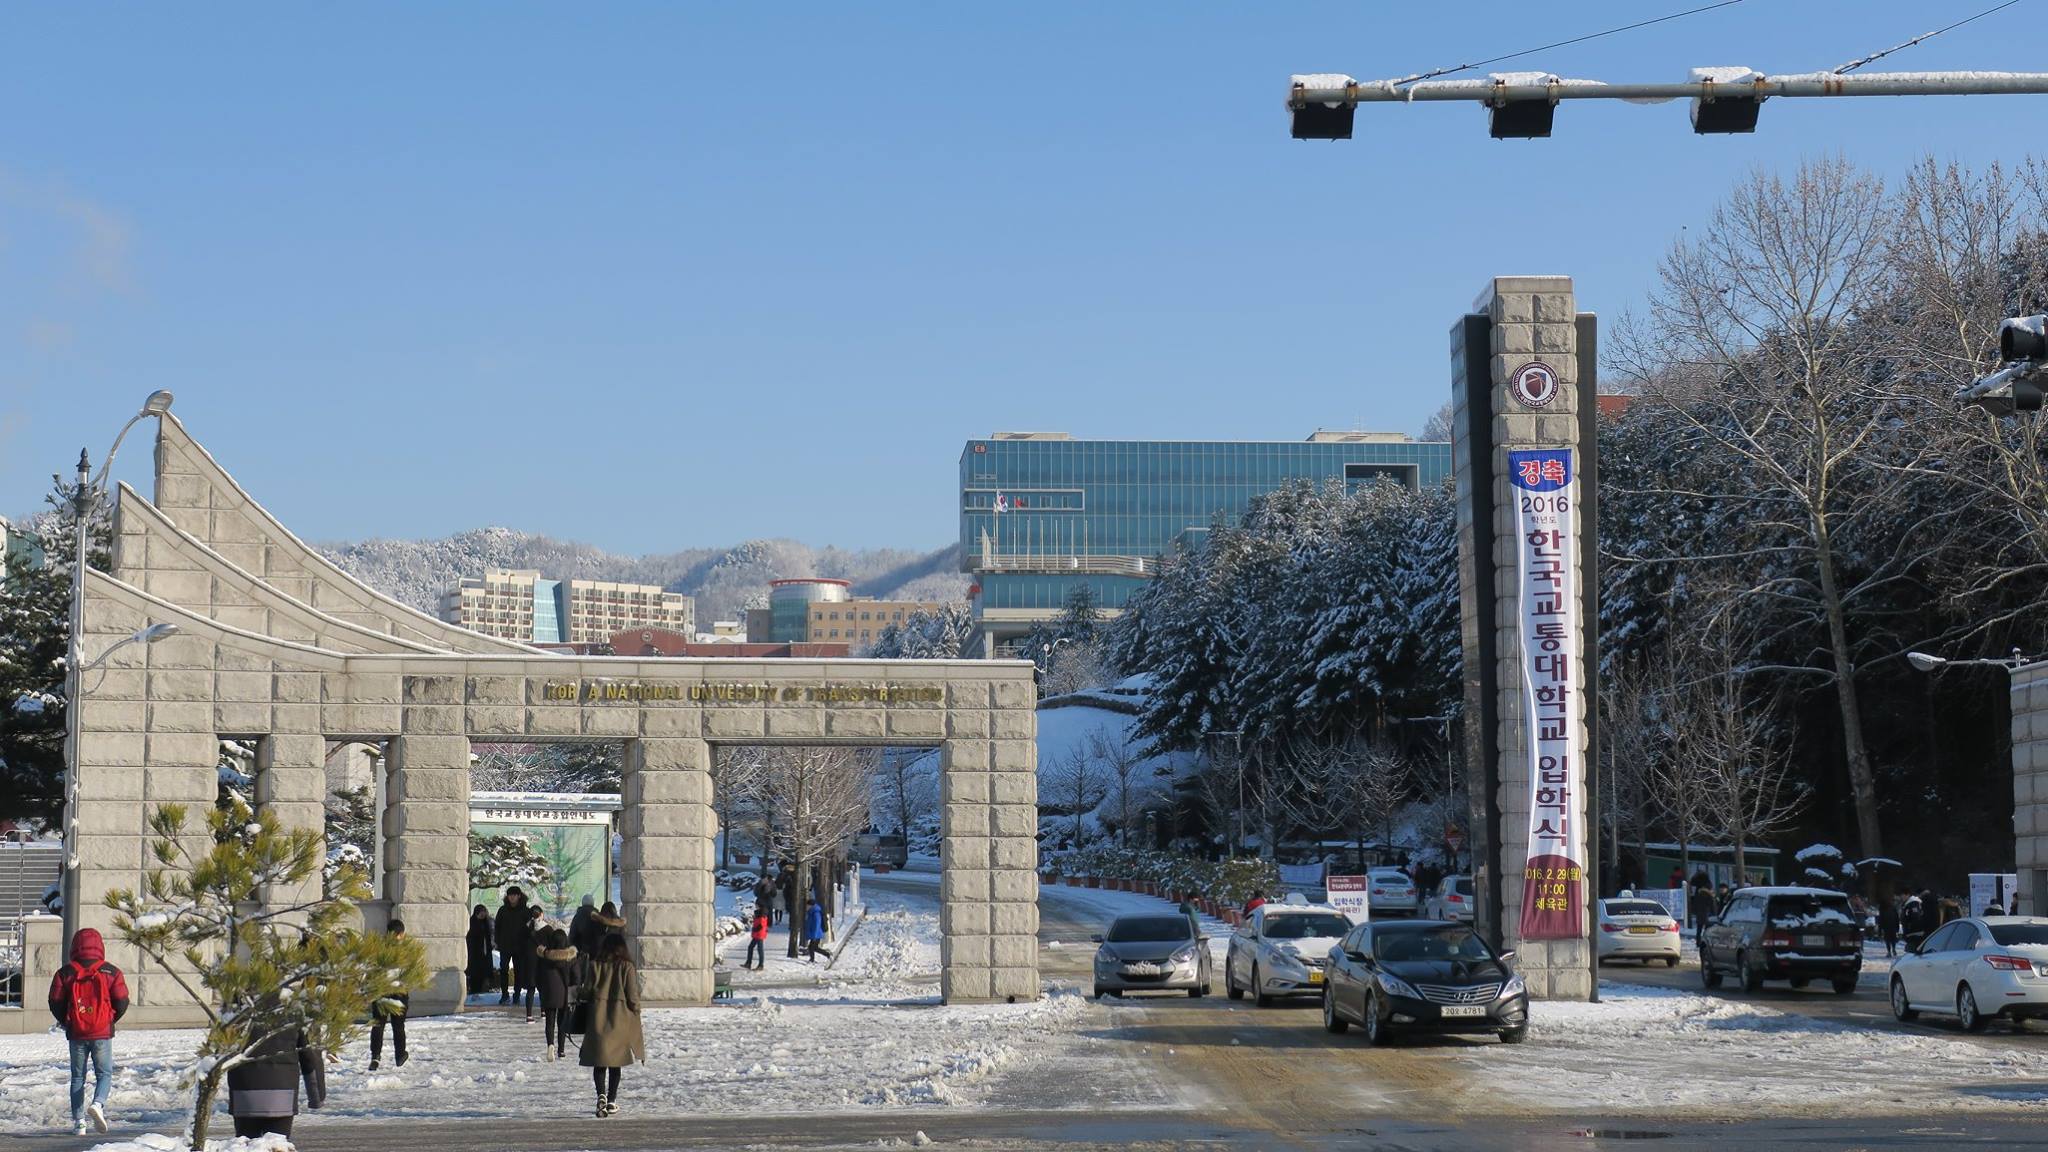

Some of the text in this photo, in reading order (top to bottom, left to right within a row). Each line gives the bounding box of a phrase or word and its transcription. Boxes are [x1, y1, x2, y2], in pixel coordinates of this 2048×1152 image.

[1519, 459, 1565, 486] 경축
[1521, 496, 1569, 513] 2016
[1531, 515, 1557, 524] 학년도
[547, 684, 599, 700] KORA
[1526, 529, 1571, 847] 한국교통대학교 입학식
[1537, 884, 1565, 894] 11:00
[1536, 897, 1567, 911] 체육관
